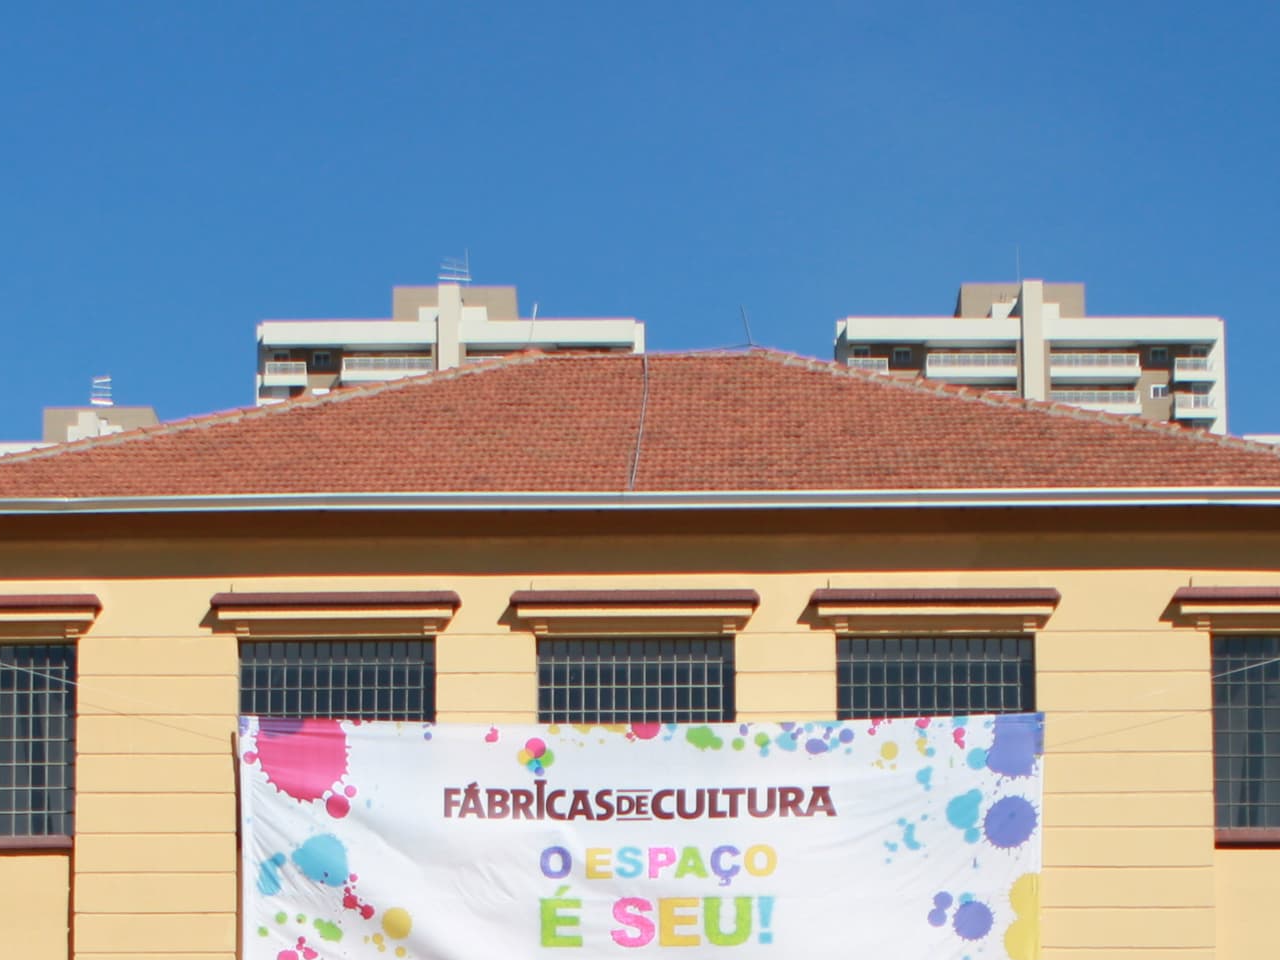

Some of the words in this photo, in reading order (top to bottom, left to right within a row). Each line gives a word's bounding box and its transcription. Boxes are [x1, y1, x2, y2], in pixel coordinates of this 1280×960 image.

[443, 779, 615, 821] FÁBRICAS
[651, 785, 837, 820] CULTURA
[539, 845, 573, 879] O
[584, 843, 778, 886] ESPAÇO
[538, 886, 583, 948] É
[610, 892, 775, 948] SEU!
